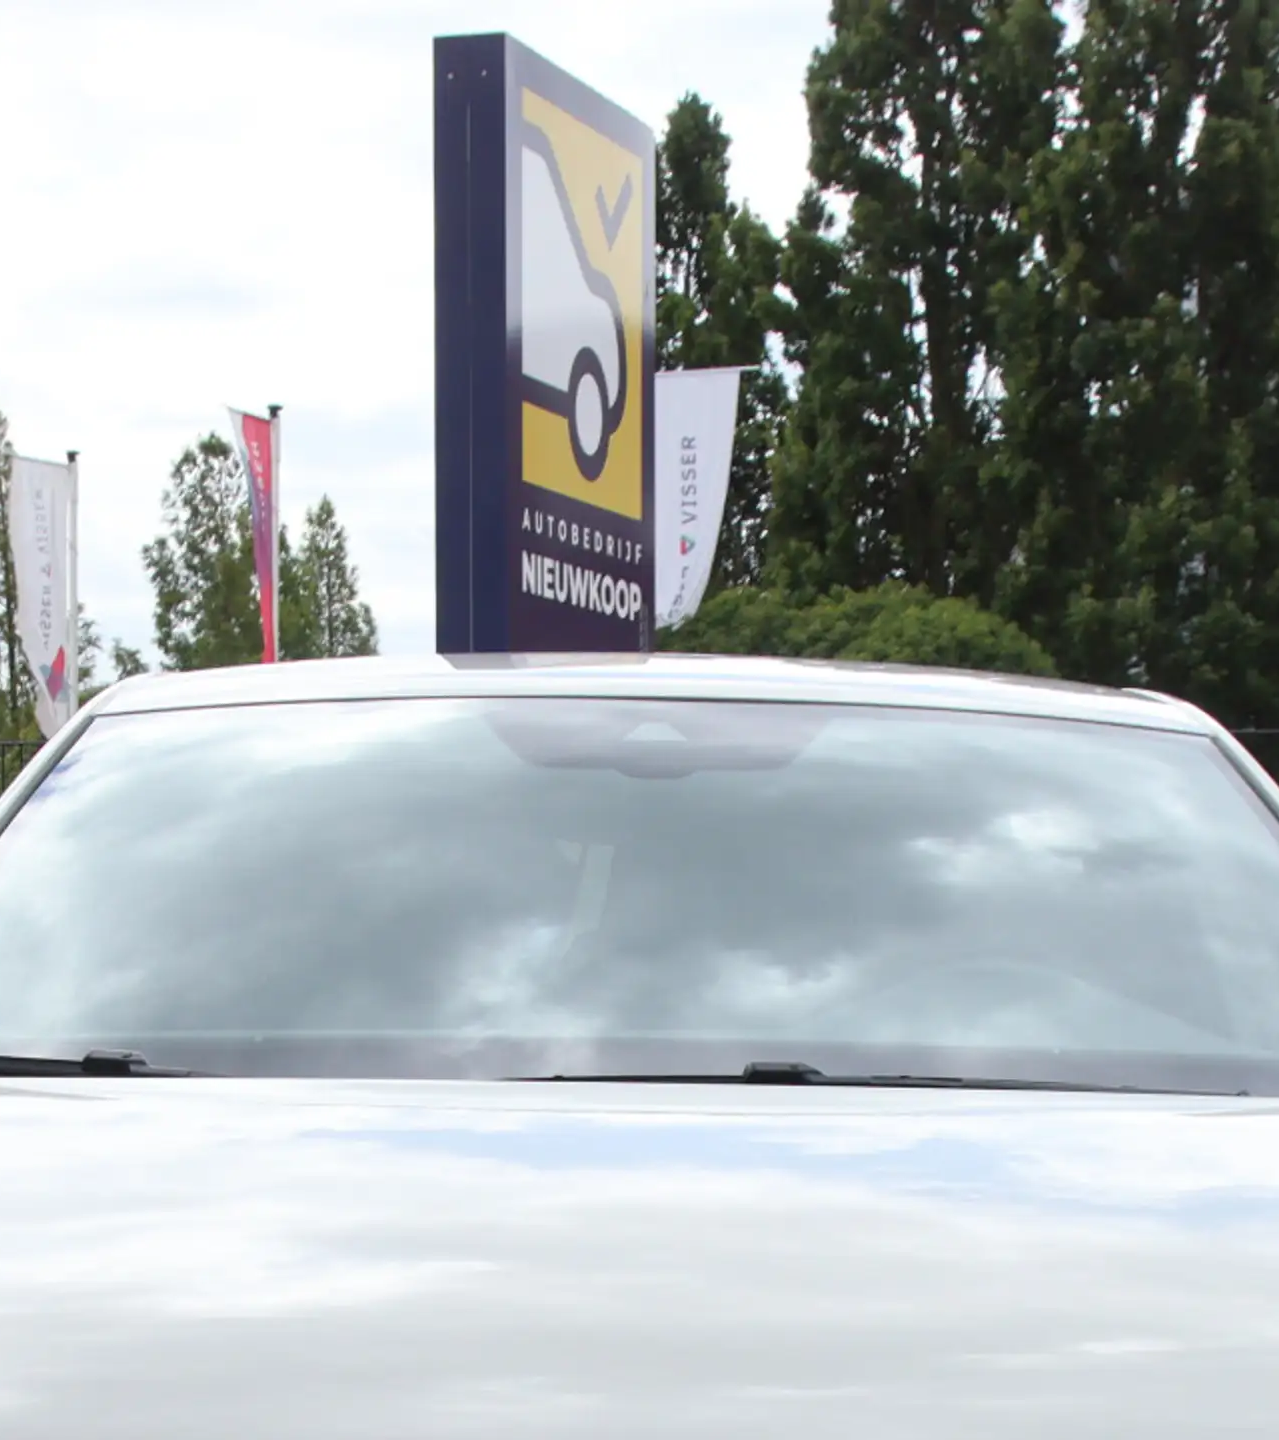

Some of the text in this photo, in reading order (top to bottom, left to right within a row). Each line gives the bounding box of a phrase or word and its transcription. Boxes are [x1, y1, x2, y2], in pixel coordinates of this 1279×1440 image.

[681, 435, 697, 525] VISSER
[522, 507, 642, 564] AUTOBEDRIJF
[521, 549, 641, 621] NIEUWKOOP
